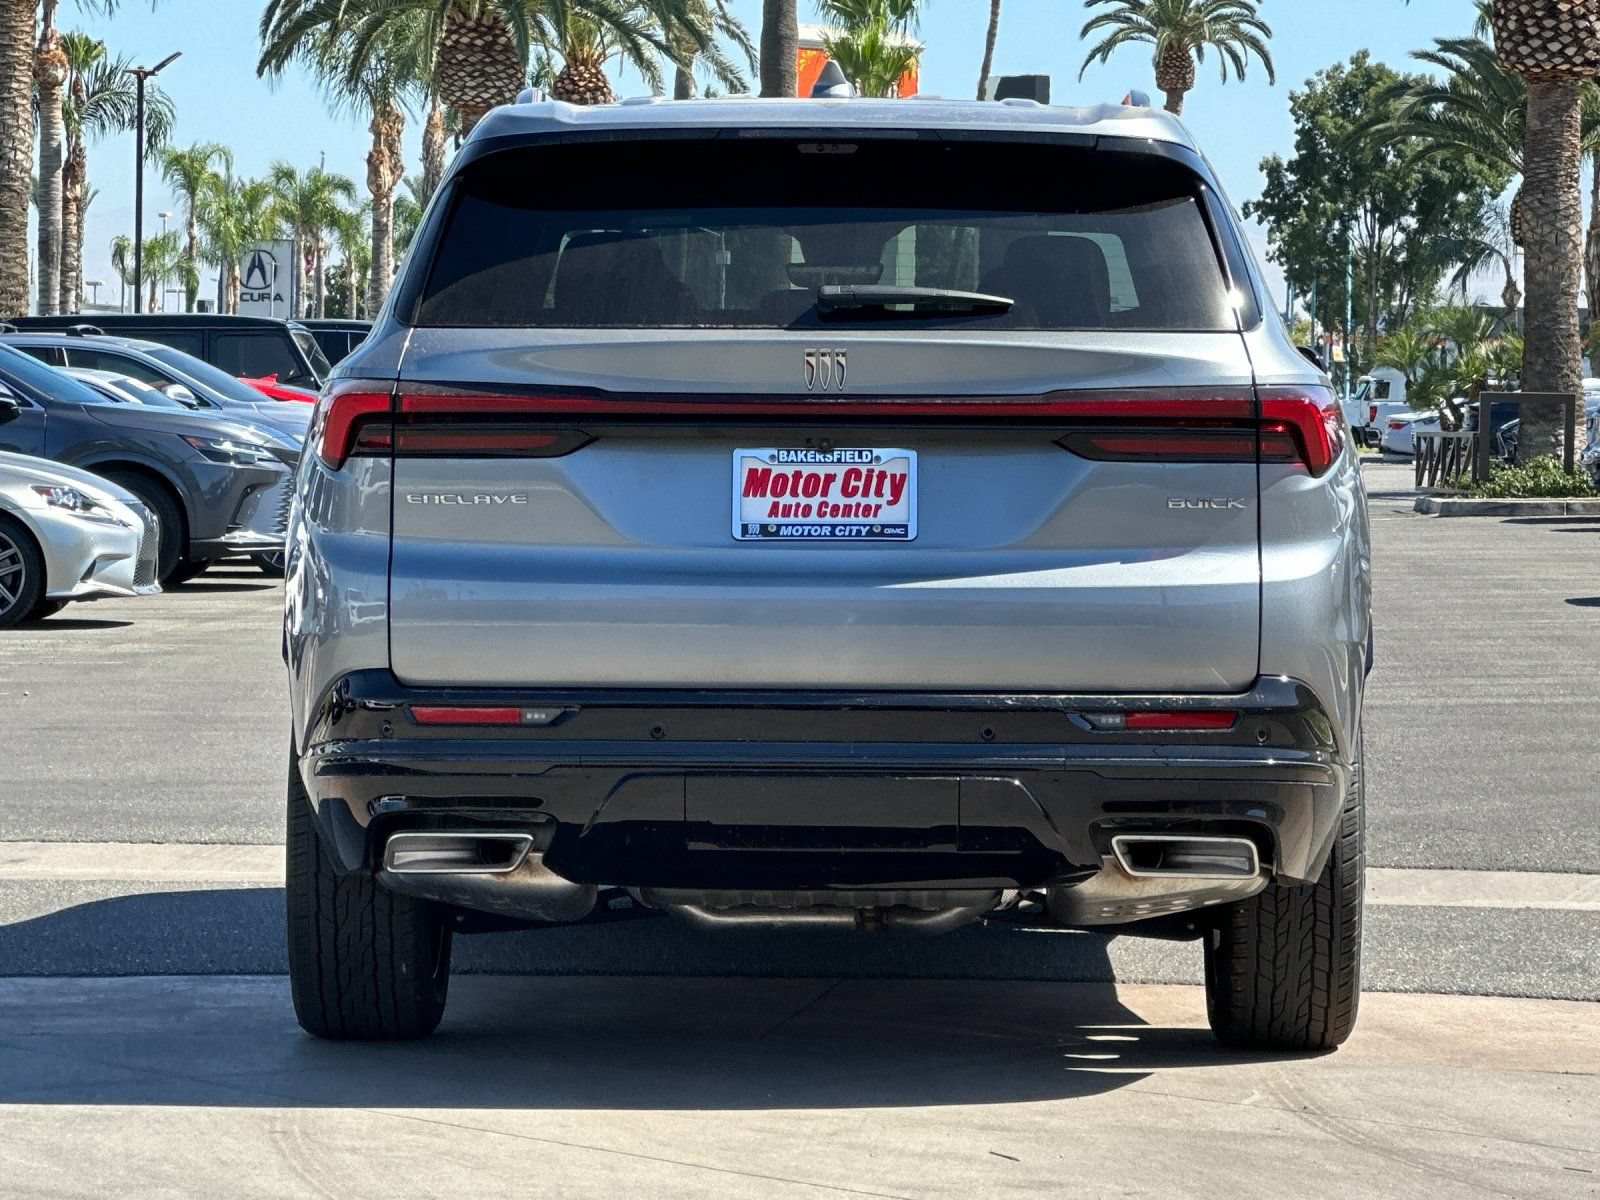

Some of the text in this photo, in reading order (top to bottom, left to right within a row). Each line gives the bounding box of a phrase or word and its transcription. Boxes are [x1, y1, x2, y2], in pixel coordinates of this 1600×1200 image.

[239, 292, 284, 303] CURA
[778, 449, 872, 463] BAKERSFIELD
[742, 467, 907, 506] Motor City
[406, 494, 528, 505] ENCLAVE
[1167, 498, 1247, 509] BUICK
[767, 500, 882, 519] Auto Center
[779, 525, 870, 537] MOTOR CITY
[883, 527, 906, 535] GMC
